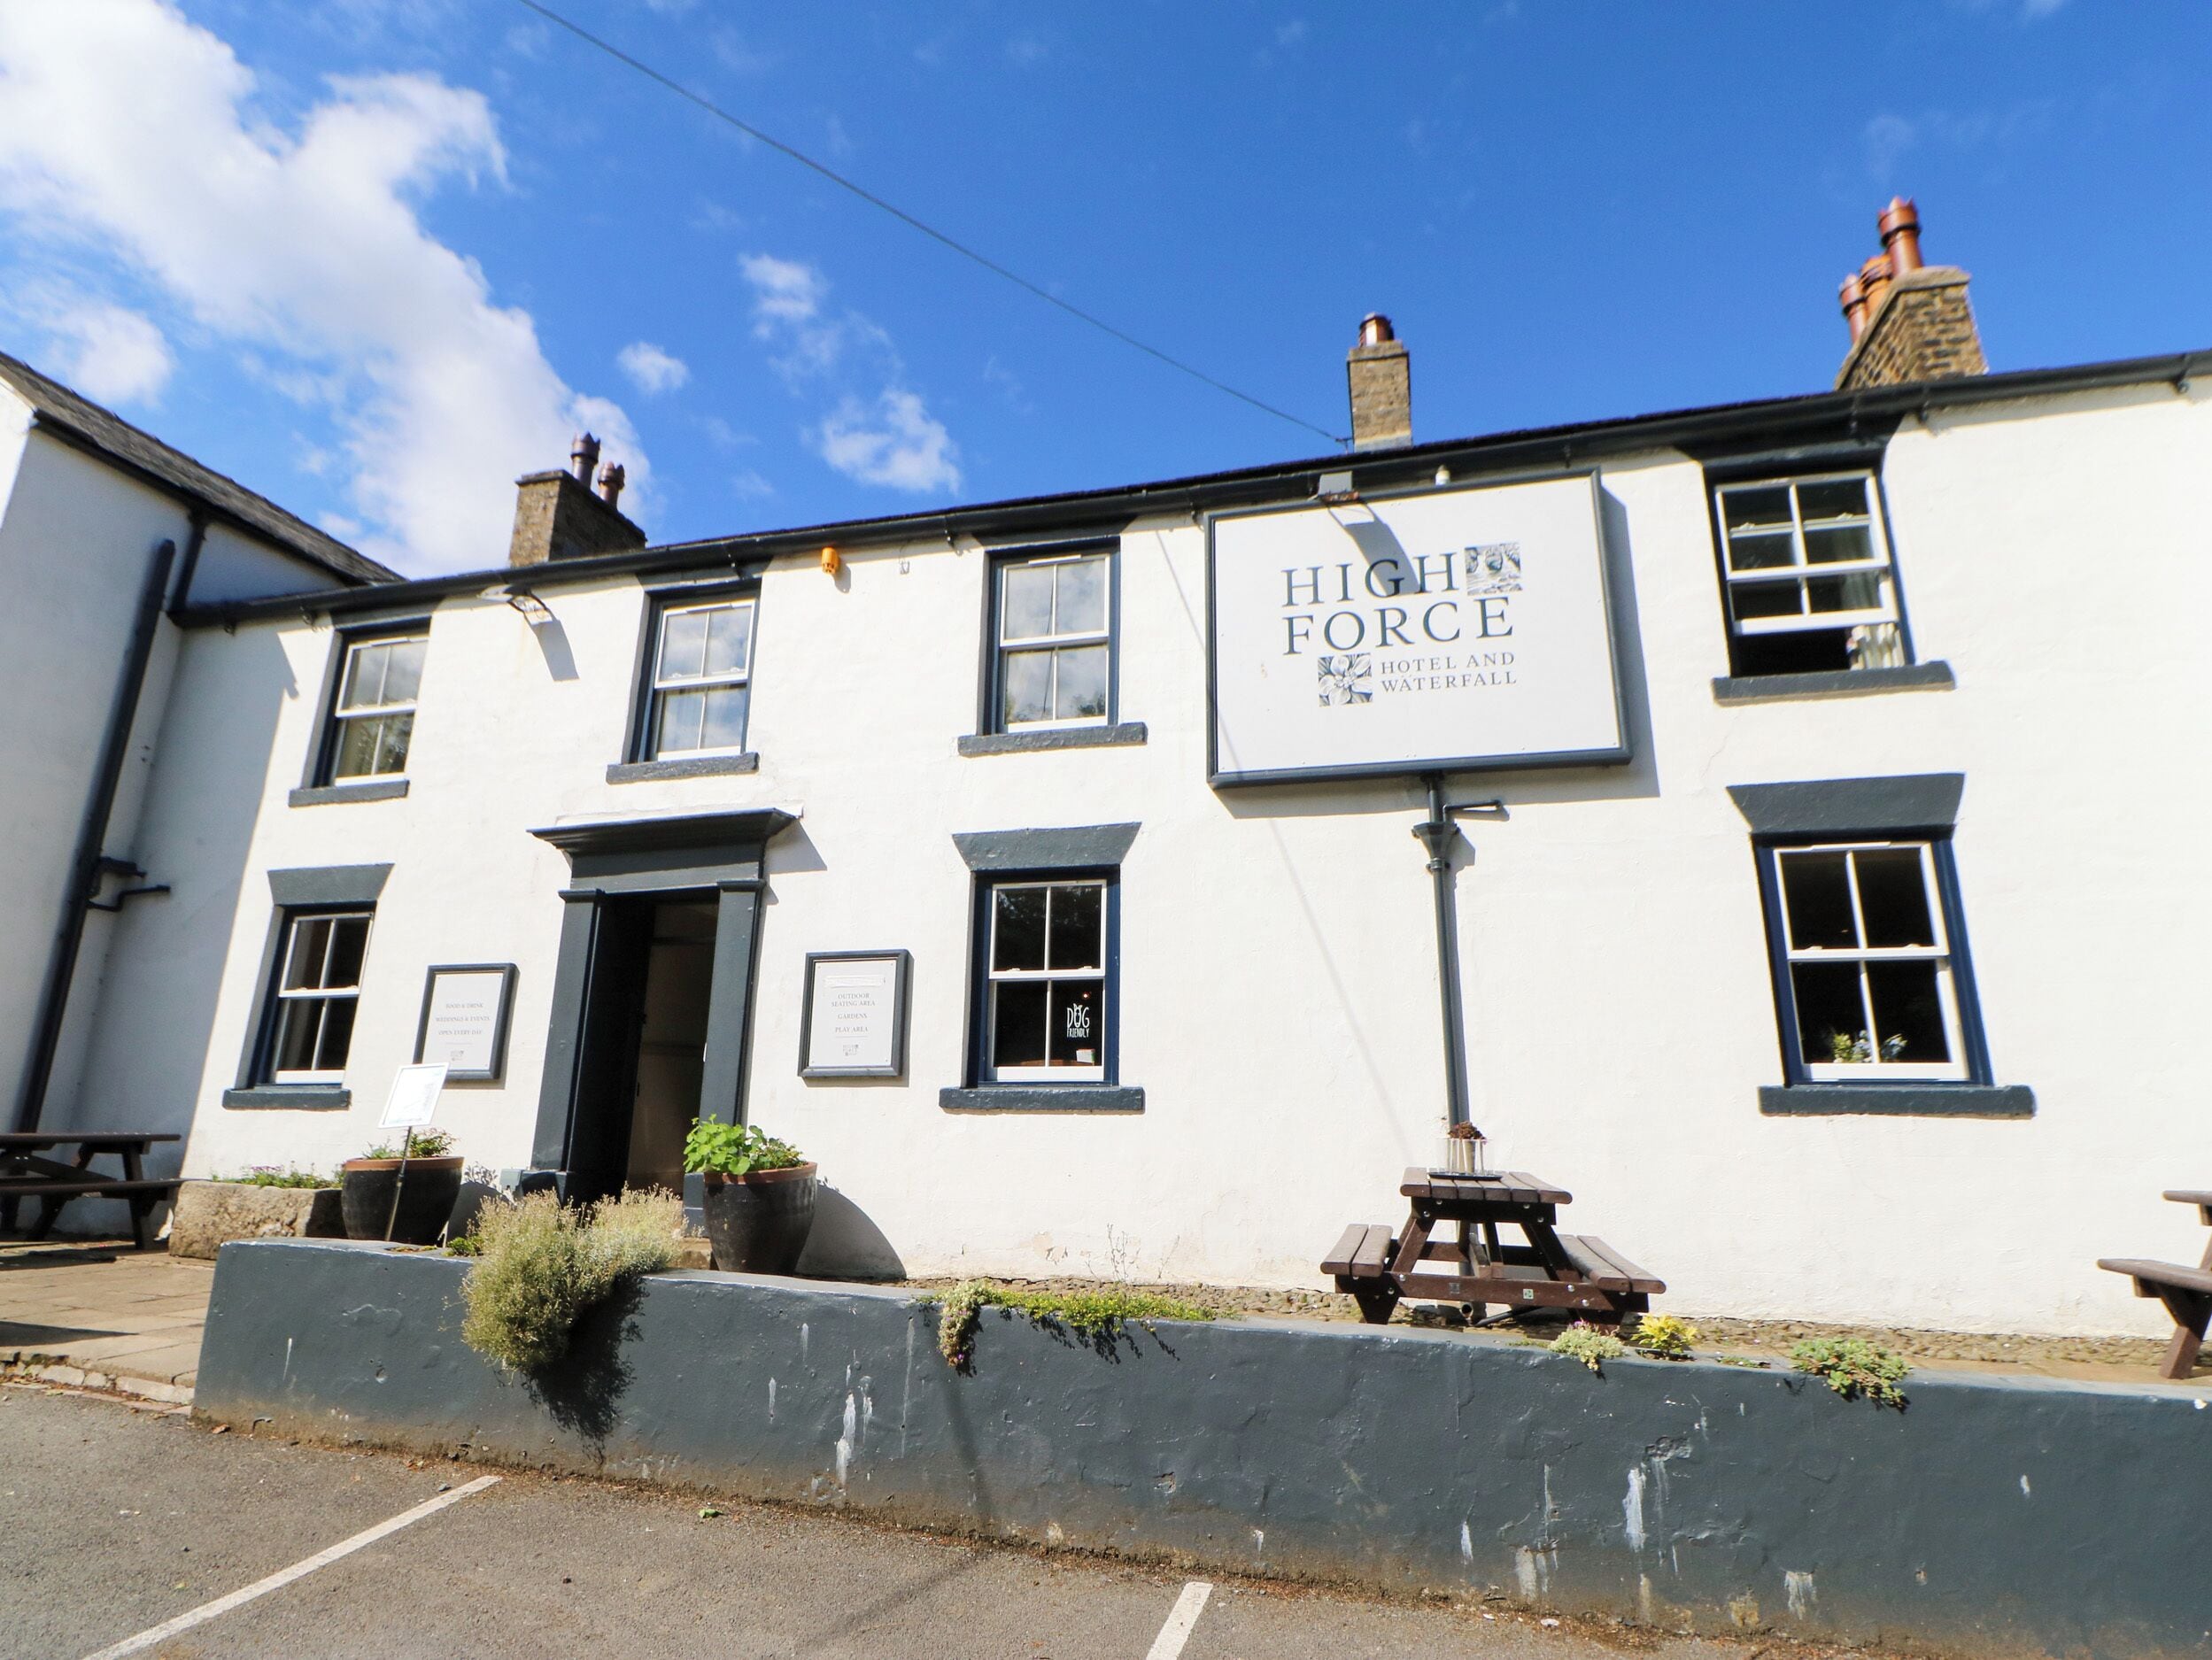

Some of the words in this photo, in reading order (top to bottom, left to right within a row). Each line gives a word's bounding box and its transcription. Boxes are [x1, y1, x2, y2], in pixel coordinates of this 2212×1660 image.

[1281, 552, 1460, 607] HIGH
[1282, 596, 1514, 656] FORCE
[1381, 656, 1458, 675] HOTEL
[1466, 651, 1515, 668] AND
[1381, 670, 1517, 693] WATERFALL
[1066, 1003, 1090, 1028] DOG
[1066, 1028, 1090, 1038] FRIENDLY
